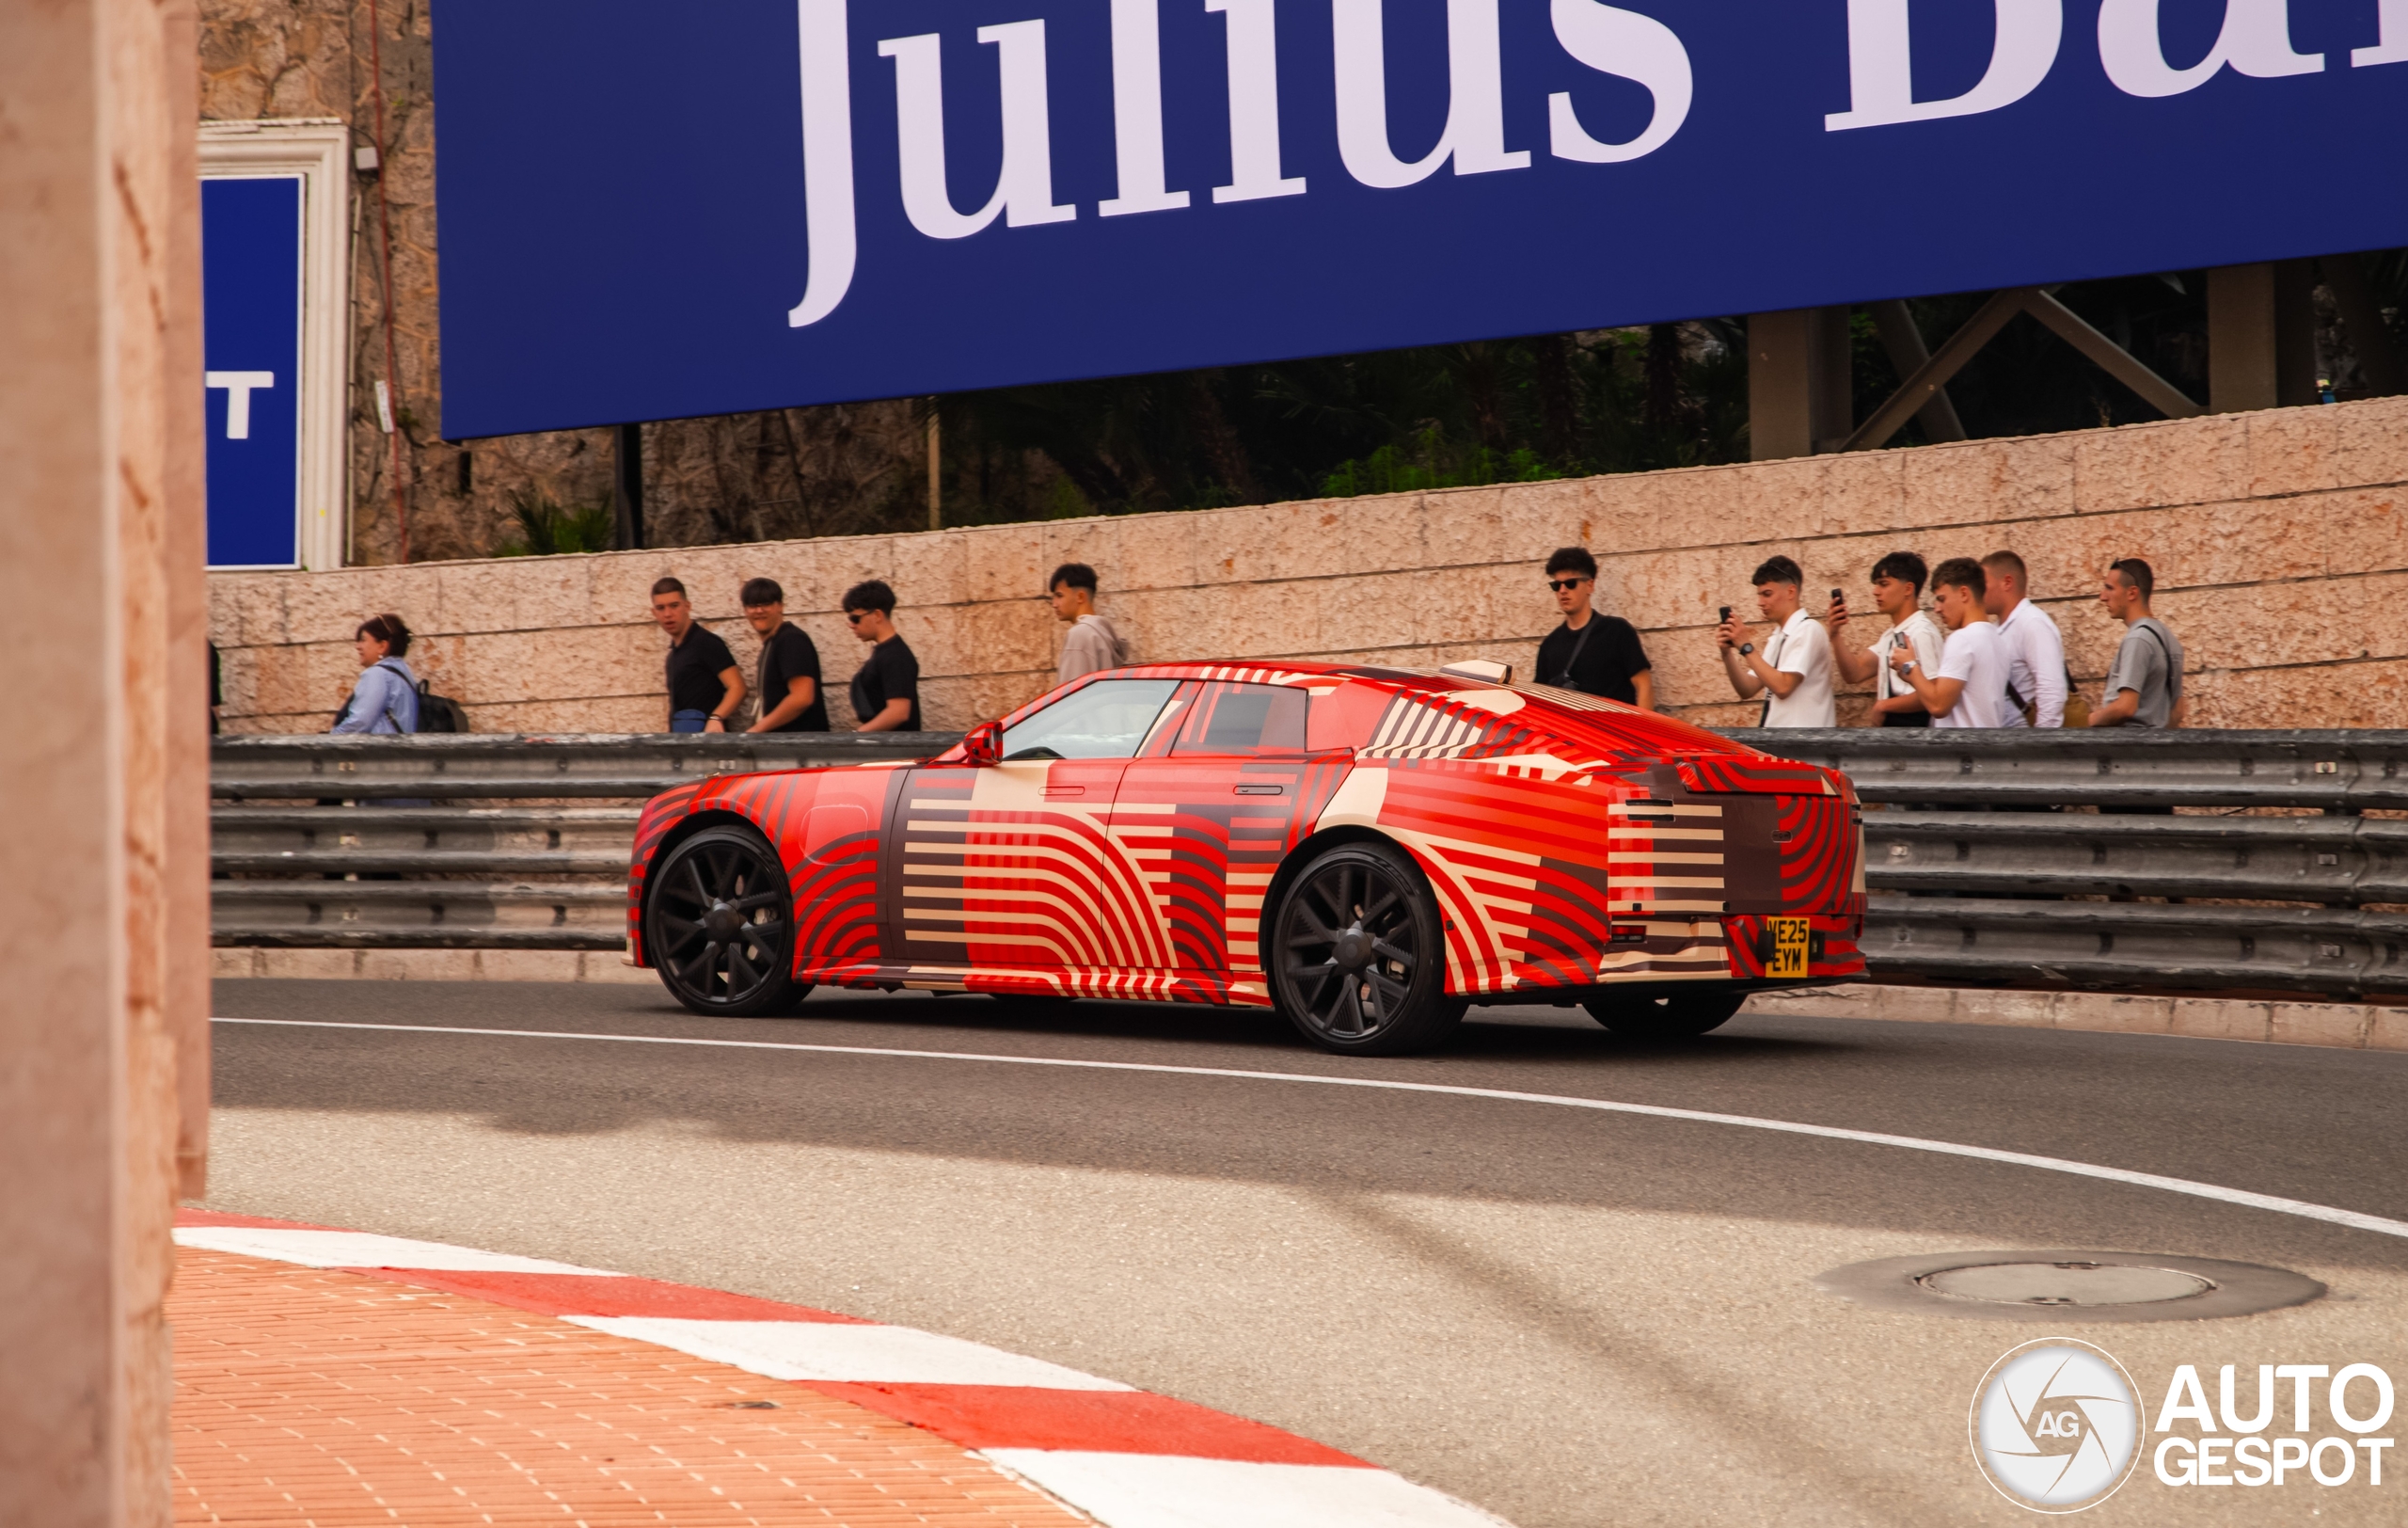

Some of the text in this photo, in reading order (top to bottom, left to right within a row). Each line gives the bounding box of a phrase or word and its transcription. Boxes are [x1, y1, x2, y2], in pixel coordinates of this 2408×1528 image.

[789, 0, 1692, 327] Julius
[205, 371, 275, 439] T
[1772, 947, 1801, 972] EYM
